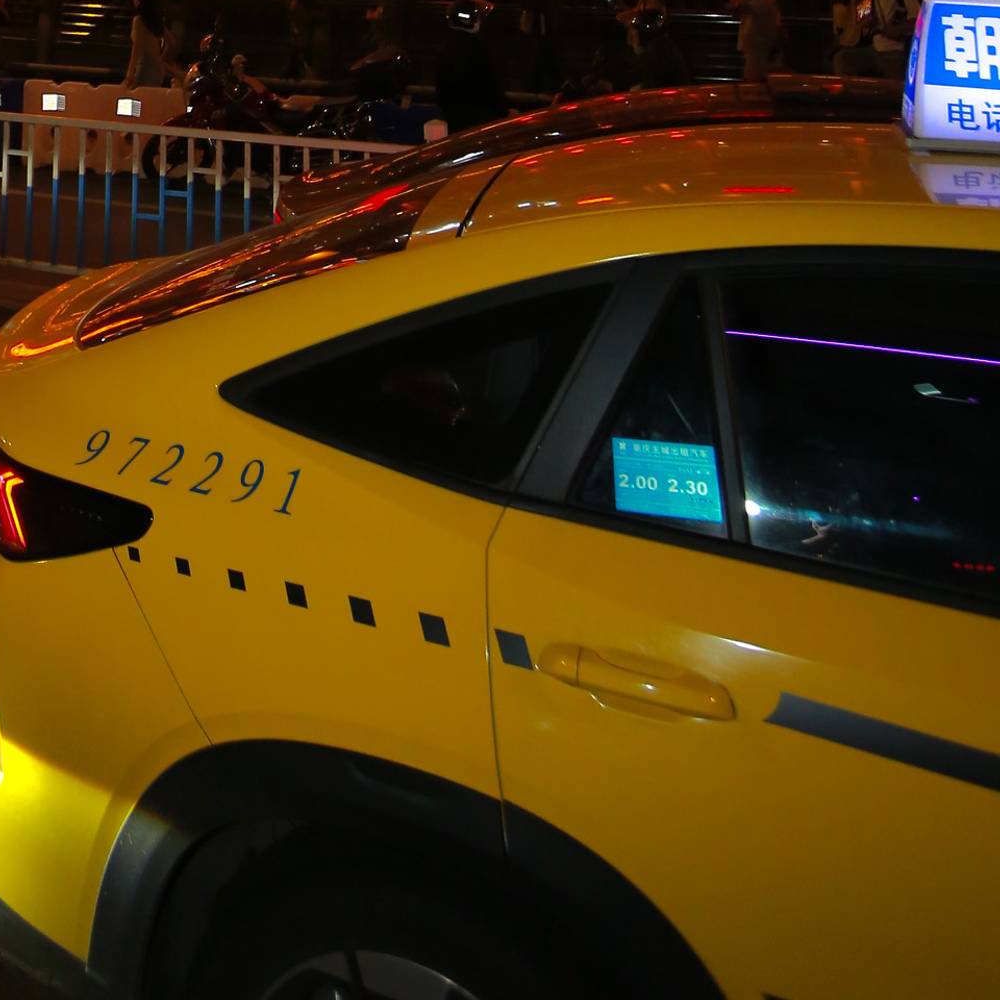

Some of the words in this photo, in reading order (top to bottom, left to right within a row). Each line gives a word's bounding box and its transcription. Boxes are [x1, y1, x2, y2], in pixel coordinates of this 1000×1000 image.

[75, 429, 301, 515] 972291
[619, 474, 657, 490] 2.00
[668, 479, 708, 496] 2.30
